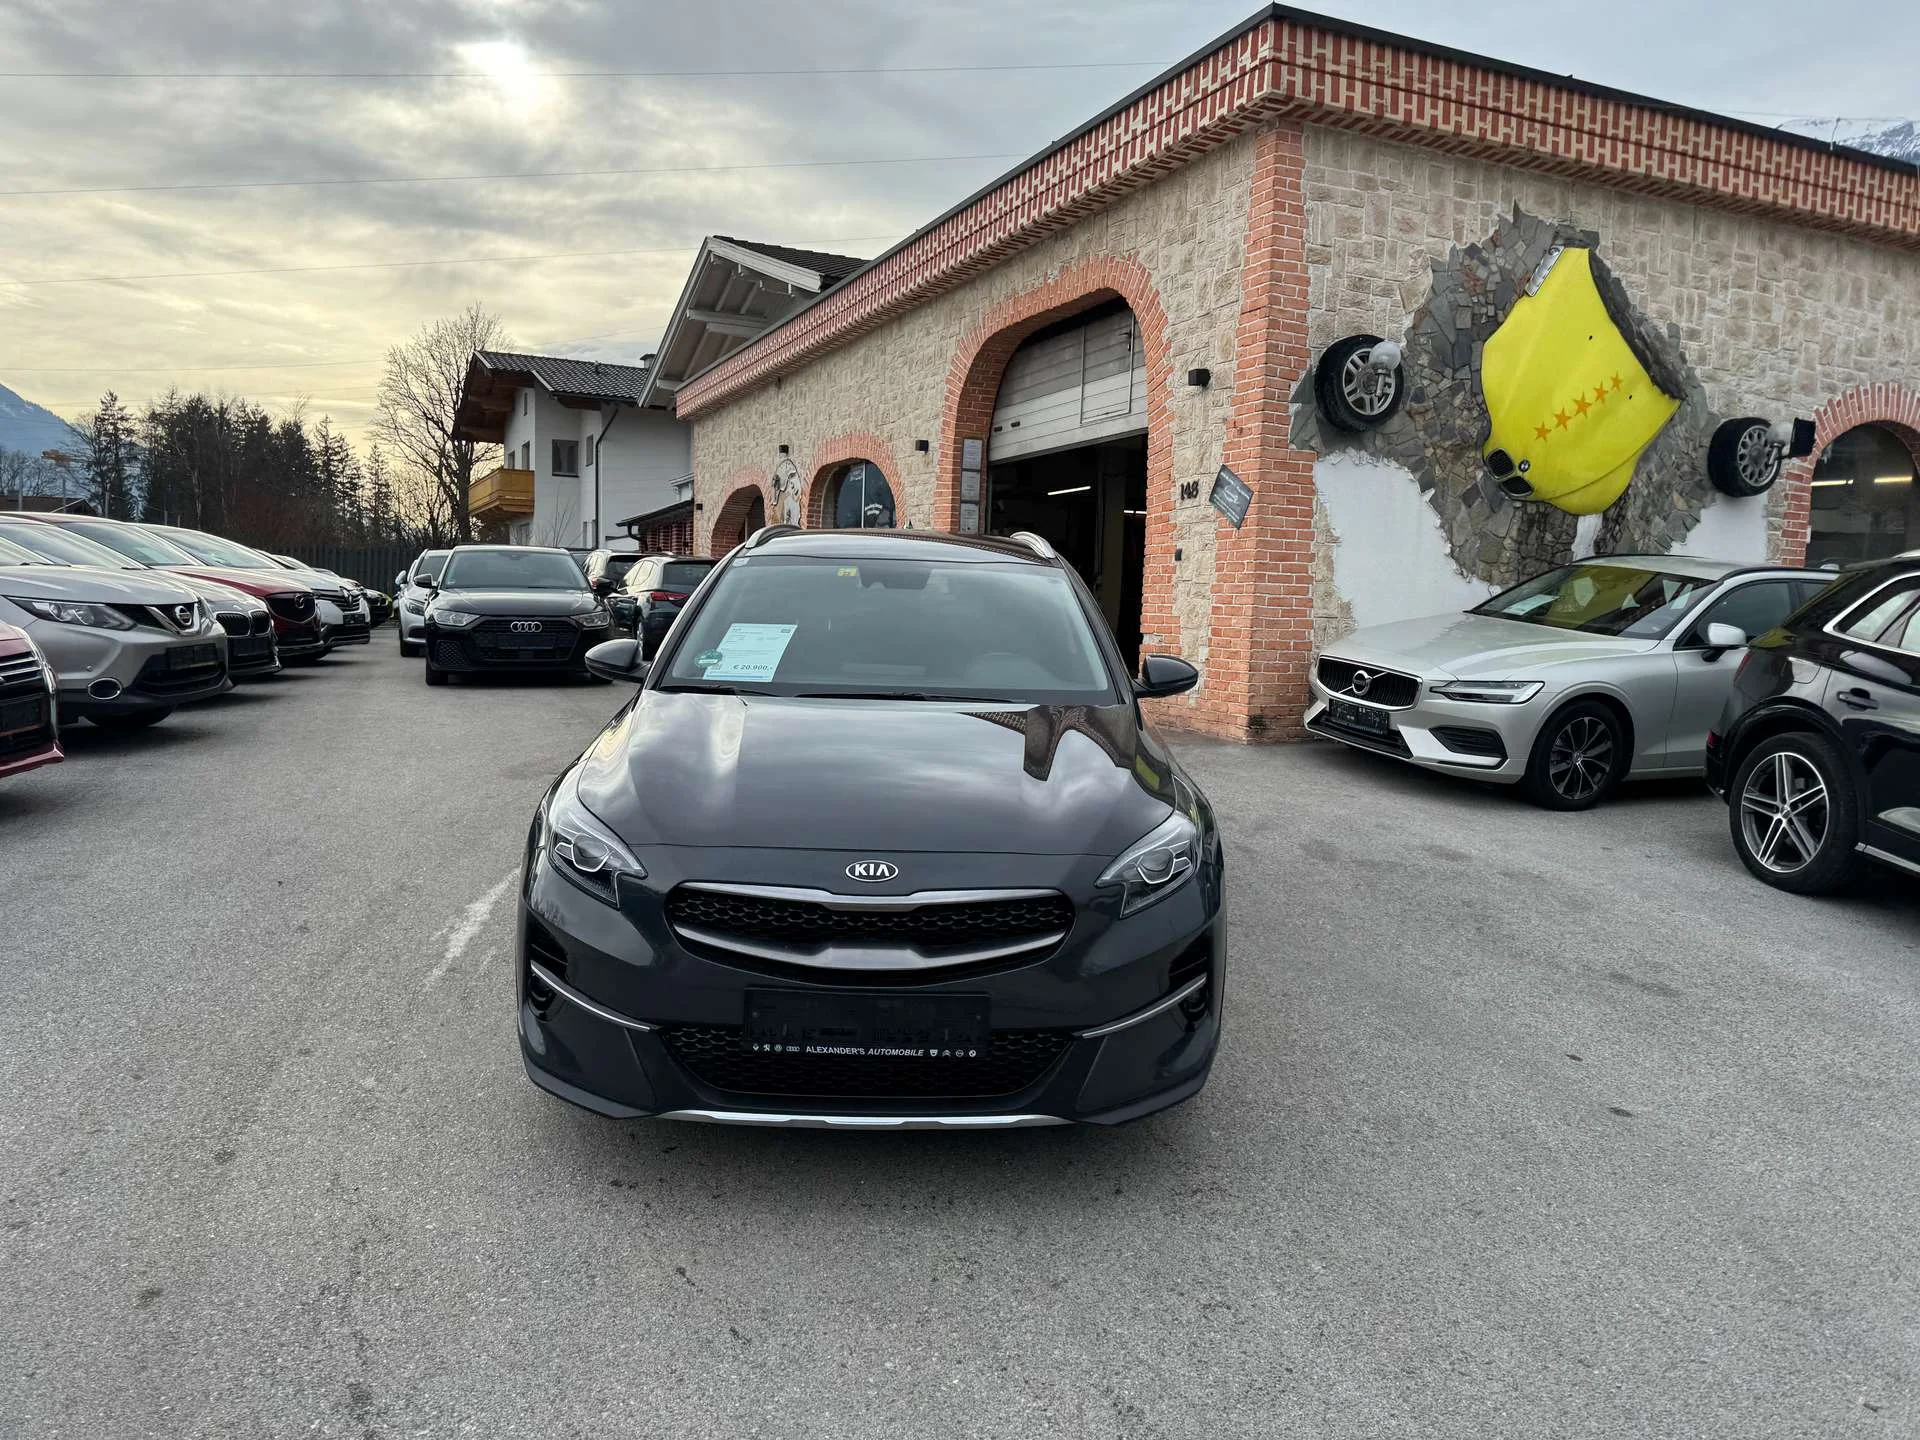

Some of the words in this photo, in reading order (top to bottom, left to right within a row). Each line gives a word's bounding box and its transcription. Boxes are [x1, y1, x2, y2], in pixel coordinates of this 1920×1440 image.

[1180, 481, 1199, 501] 148
[854, 863, 890, 877] KIA
[805, 1046, 866, 1056] ALEXANDER'S
[867, 1048, 925, 1057] AUTOMOBILE
